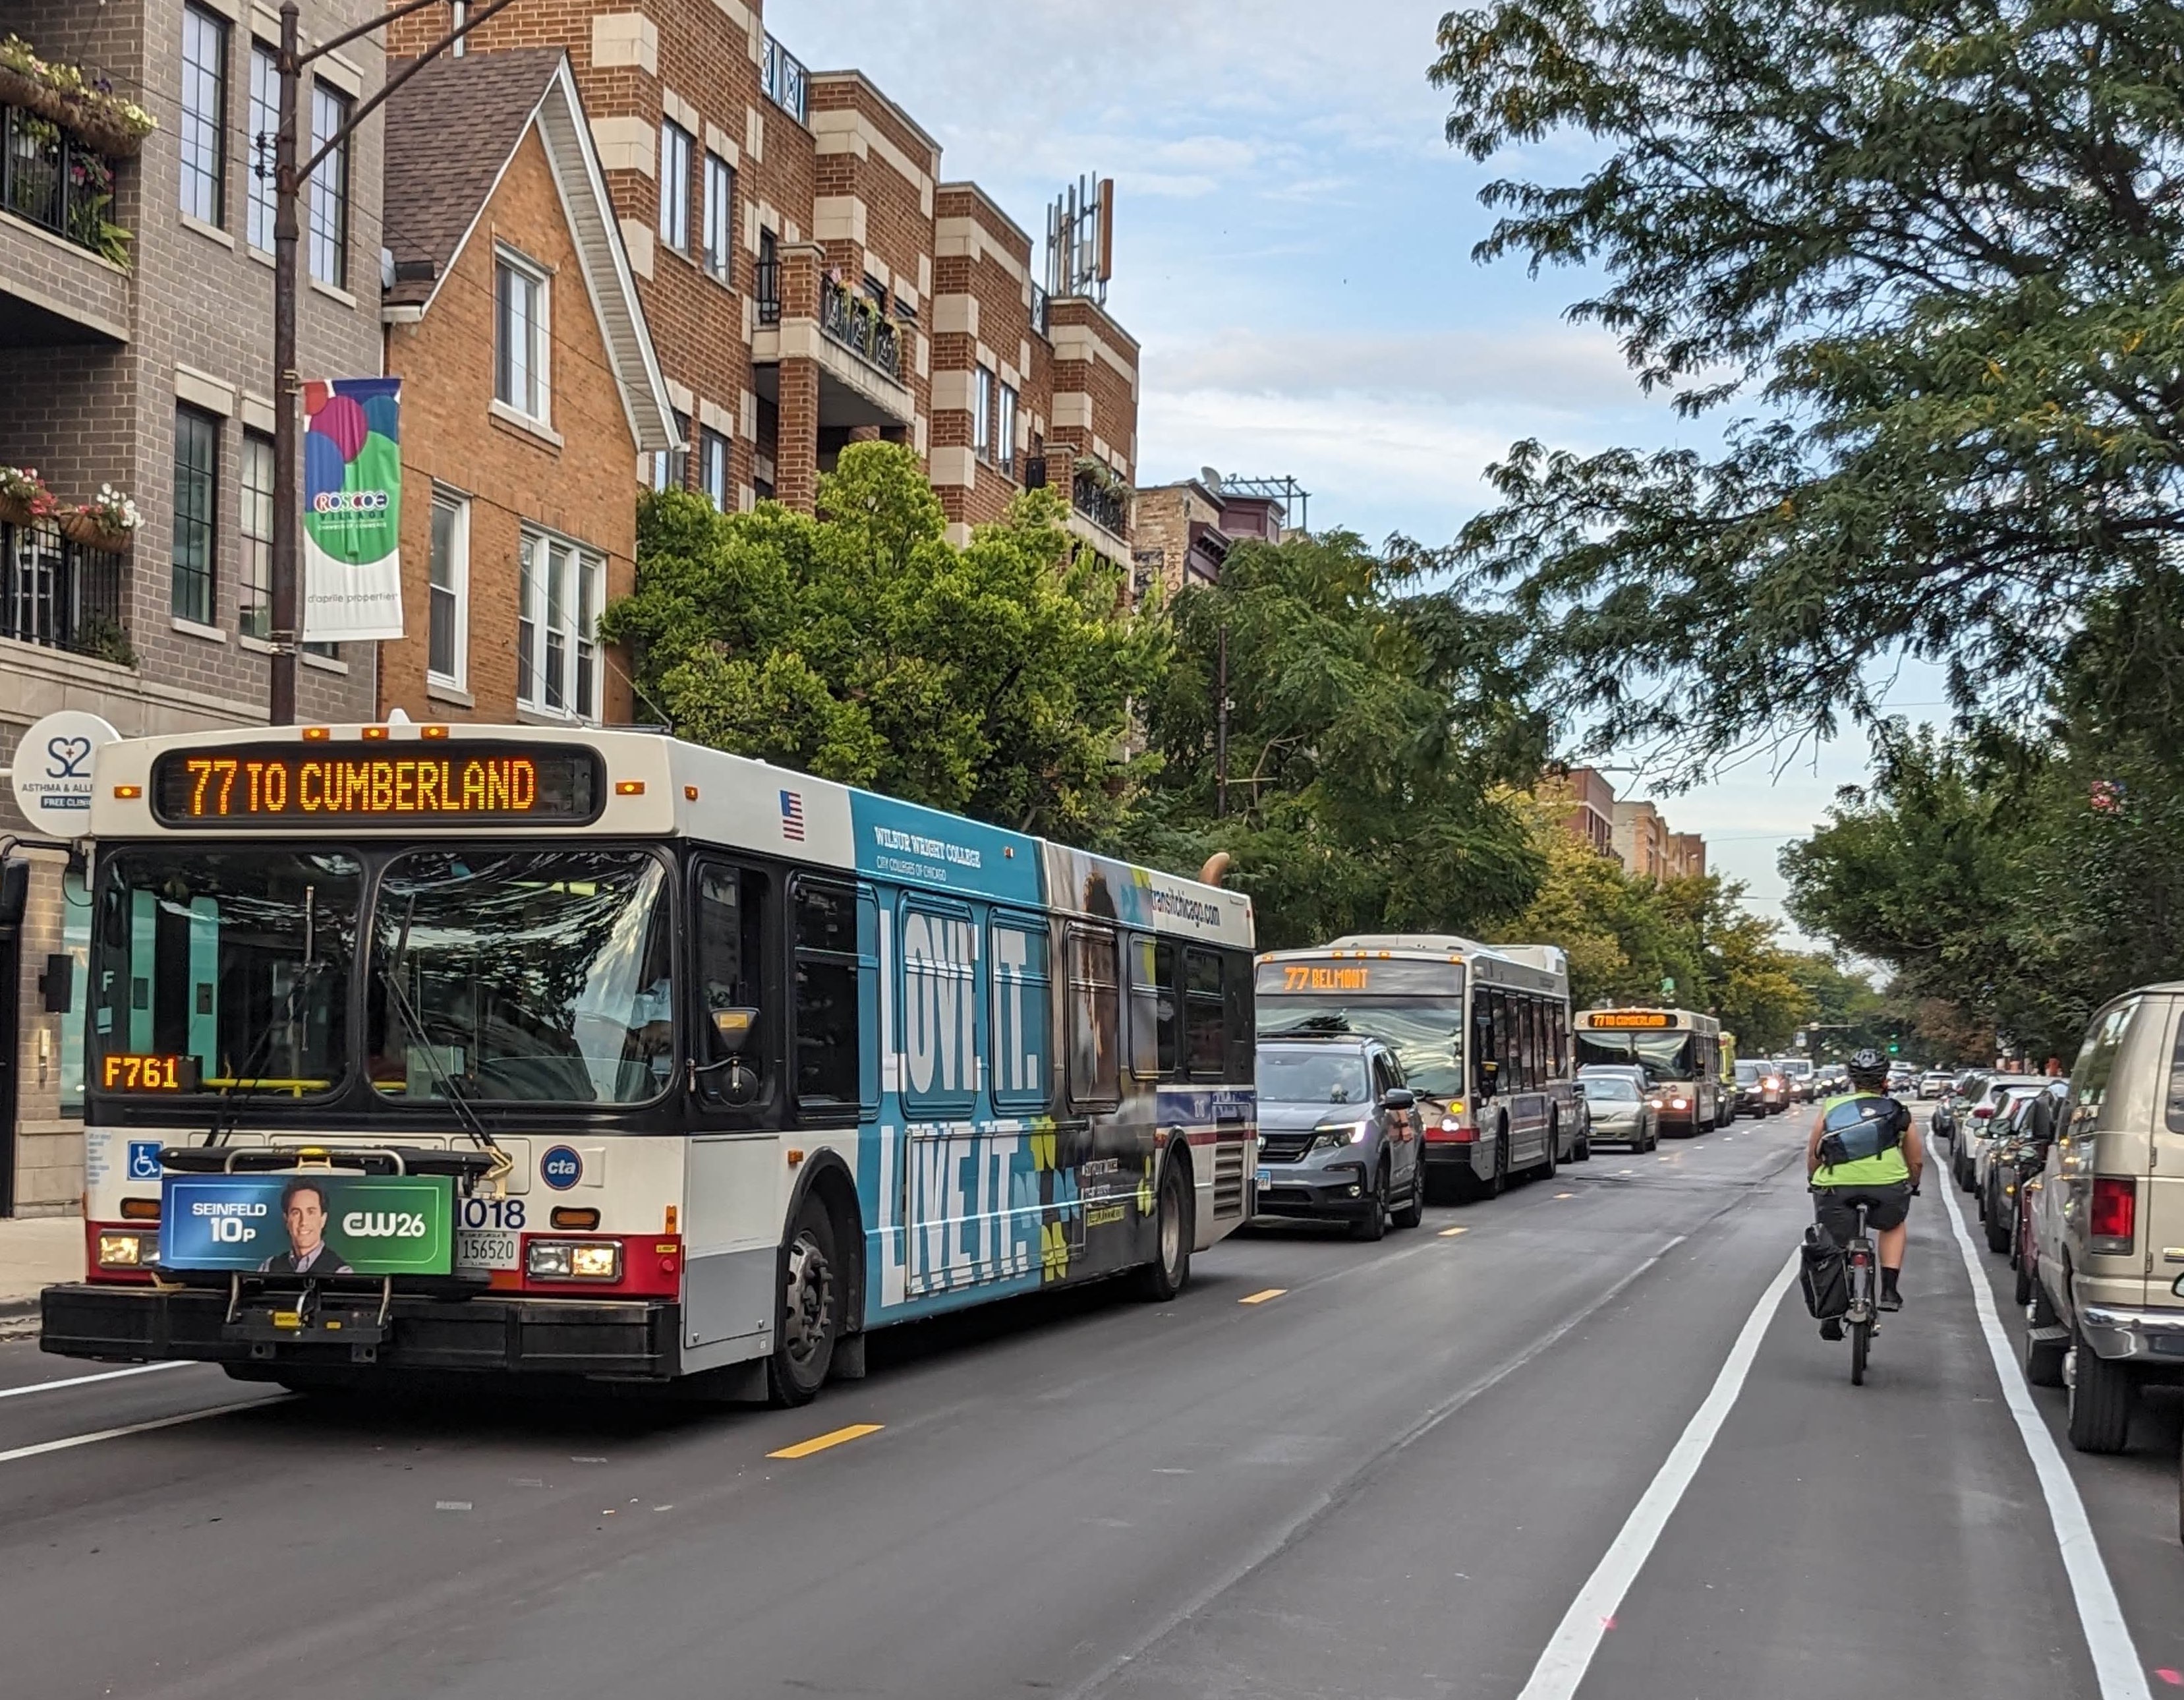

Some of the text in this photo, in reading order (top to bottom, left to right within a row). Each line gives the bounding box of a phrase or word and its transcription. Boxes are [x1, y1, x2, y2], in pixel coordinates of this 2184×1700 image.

[314, 490, 389, 513] ROSCOE
[22, 783, 62, 792] ASTHMA
[64, 784, 70, 792] &
[187, 759, 534, 815] 77 TO CUMBERLAND
[43, 798, 65, 807] FREE
[874, 825, 981, 869] WILBUR WRIGHT COLLEGE
[1284, 966, 1368, 990] 77 BELMONT
[880, 909, 1038, 1094] LOVE IT.
[1593, 1015, 1605, 1027] 77
[105, 1057, 179, 1088] F761
[547, 1159, 576, 1175] cta
[192, 1203, 267, 1216] SEINFELD
[878, 1119, 1029, 1308] LIVE IT.
[463, 1239, 514, 1260] 156520
